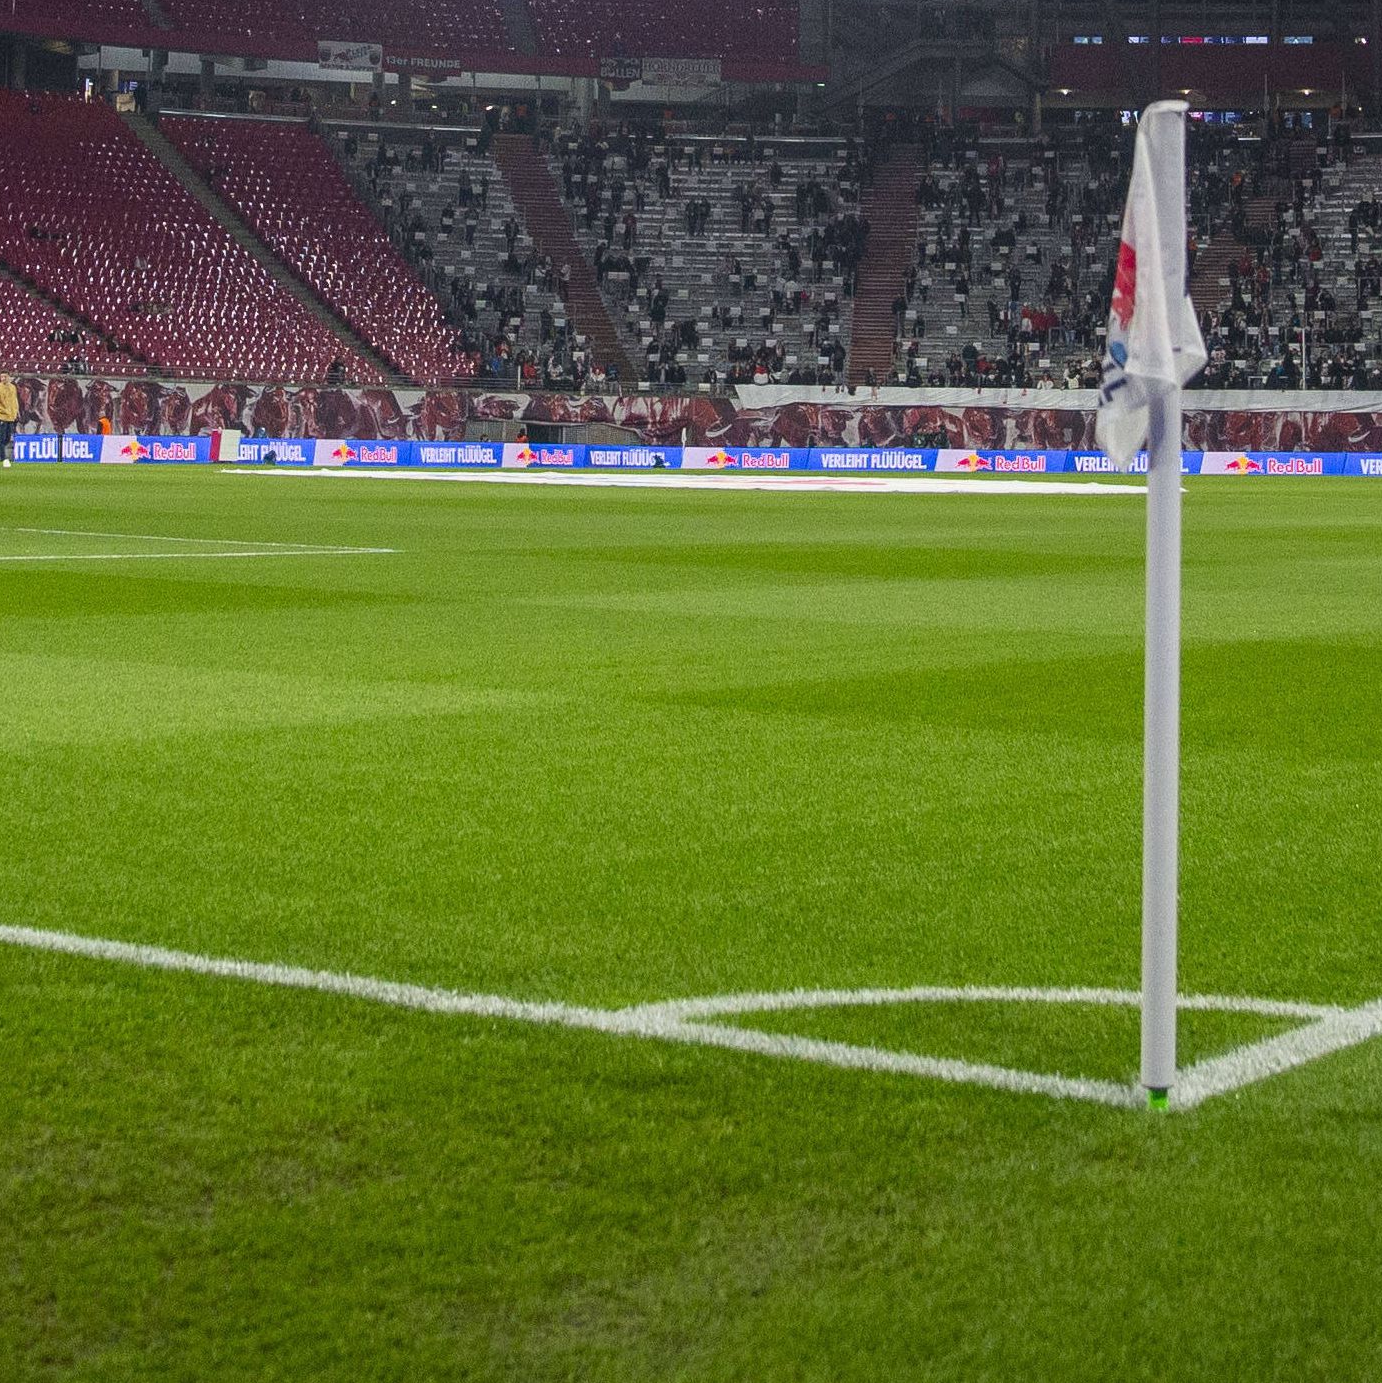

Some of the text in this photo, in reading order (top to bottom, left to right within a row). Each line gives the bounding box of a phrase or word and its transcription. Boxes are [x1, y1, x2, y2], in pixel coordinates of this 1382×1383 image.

[410, 58, 461, 69] FREUNDE
[153, 442, 196, 462] Red Bull
[360, 446, 398, 464] Red Bull
[420, 447, 455, 464] VERLEIHT
[540, 449, 573, 465] Red Bull
[742, 453, 790, 468] Red Bull
[821, 453, 867, 468] VERLEIHT
[995, 456, 1046, 471] Red Bull
[1267, 458, 1323, 475] Red Bull
